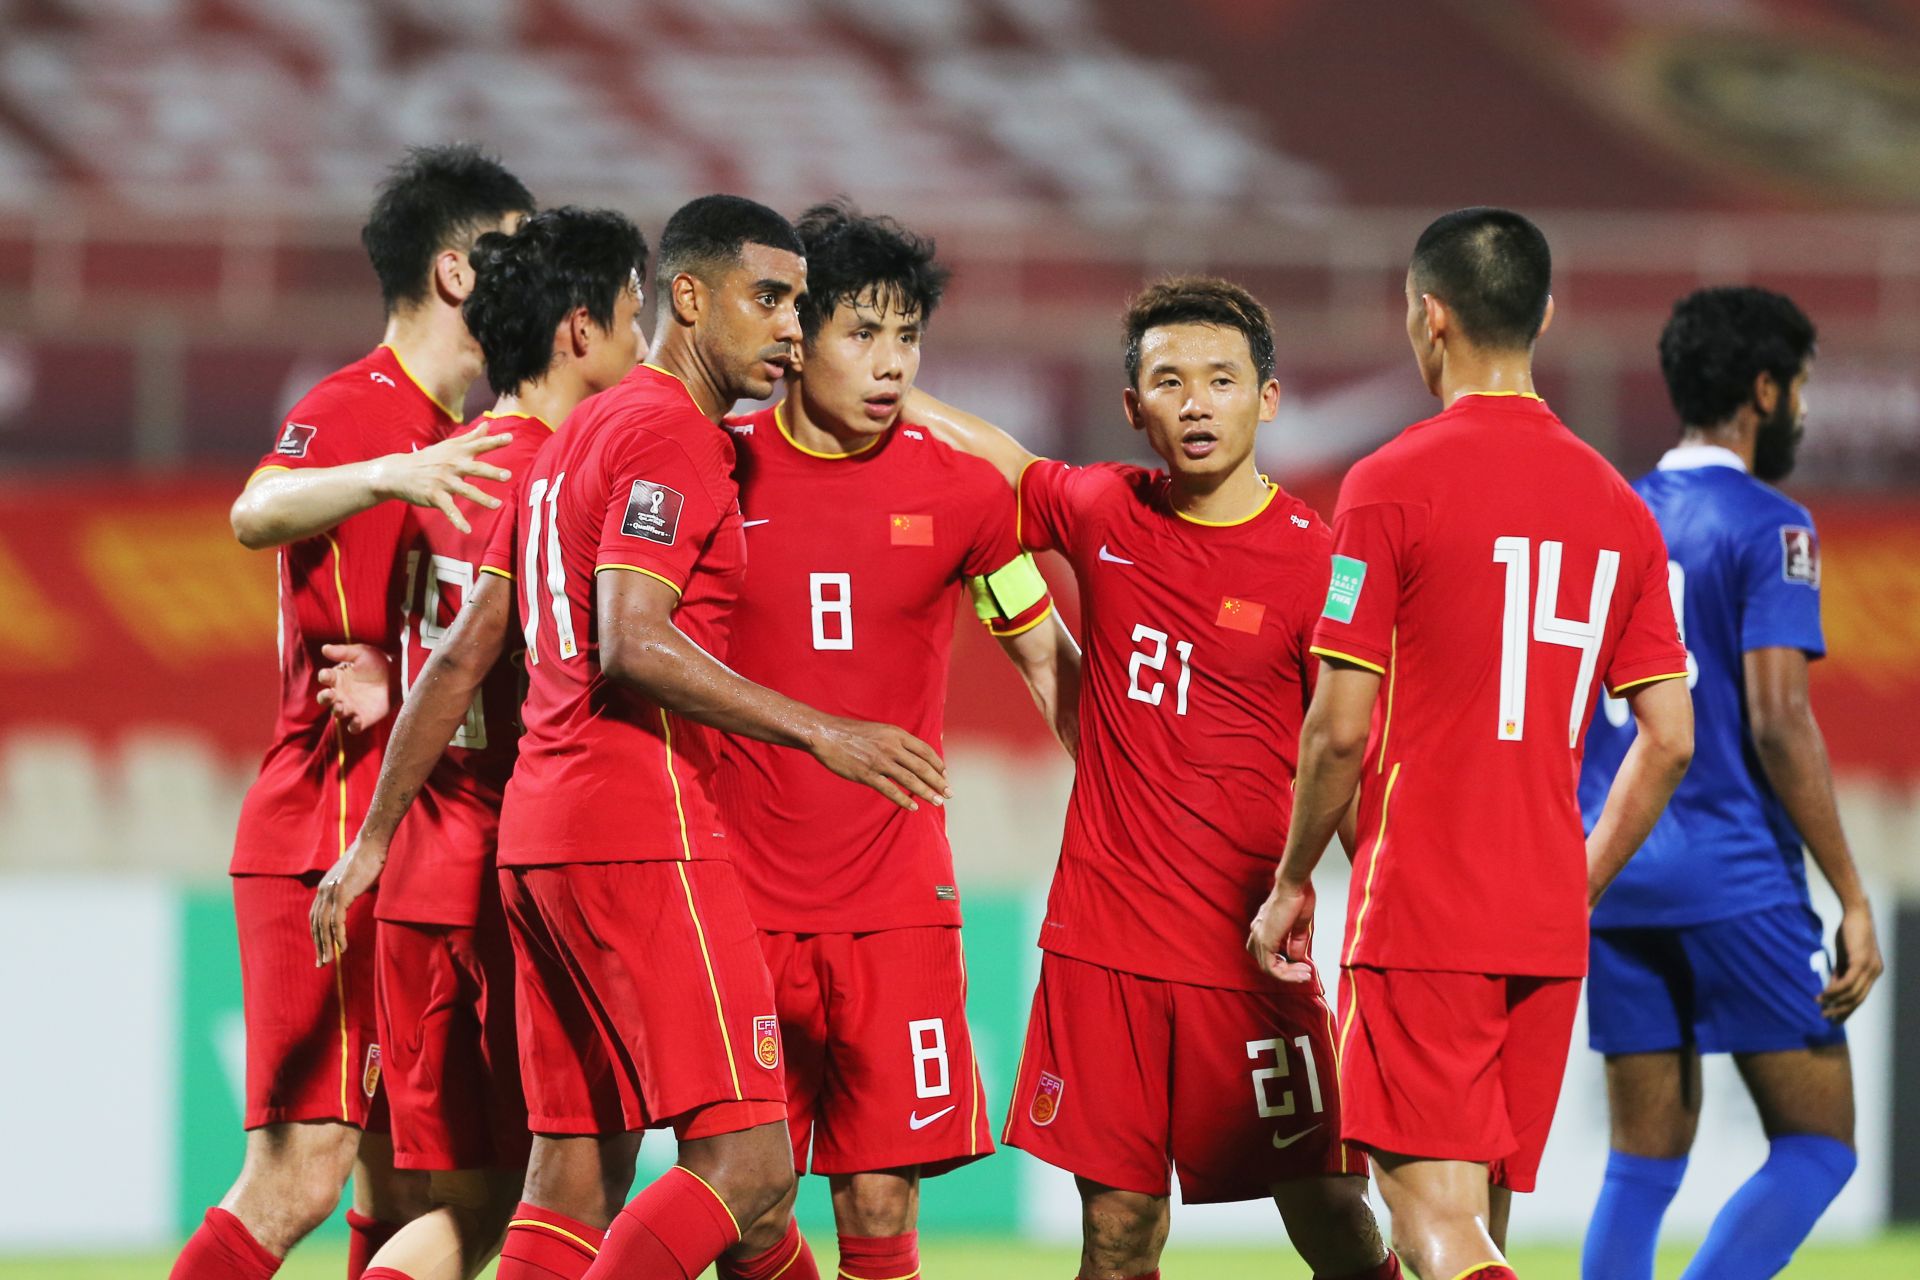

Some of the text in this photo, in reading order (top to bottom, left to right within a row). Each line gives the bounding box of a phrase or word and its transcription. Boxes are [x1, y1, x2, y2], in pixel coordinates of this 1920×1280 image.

[632, 521, 666, 537] Qualifiers
[1290, 514, 1310, 529] 中国
[524, 471, 579, 667] 11
[809, 572, 853, 651] 8
[1492, 536, 1621, 749] 14
[1127, 623, 1194, 717] 21
[908, 1017, 951, 1099] 8
[1040, 1075, 1061, 1092] CFA
[1245, 1034, 1325, 1119] 21
